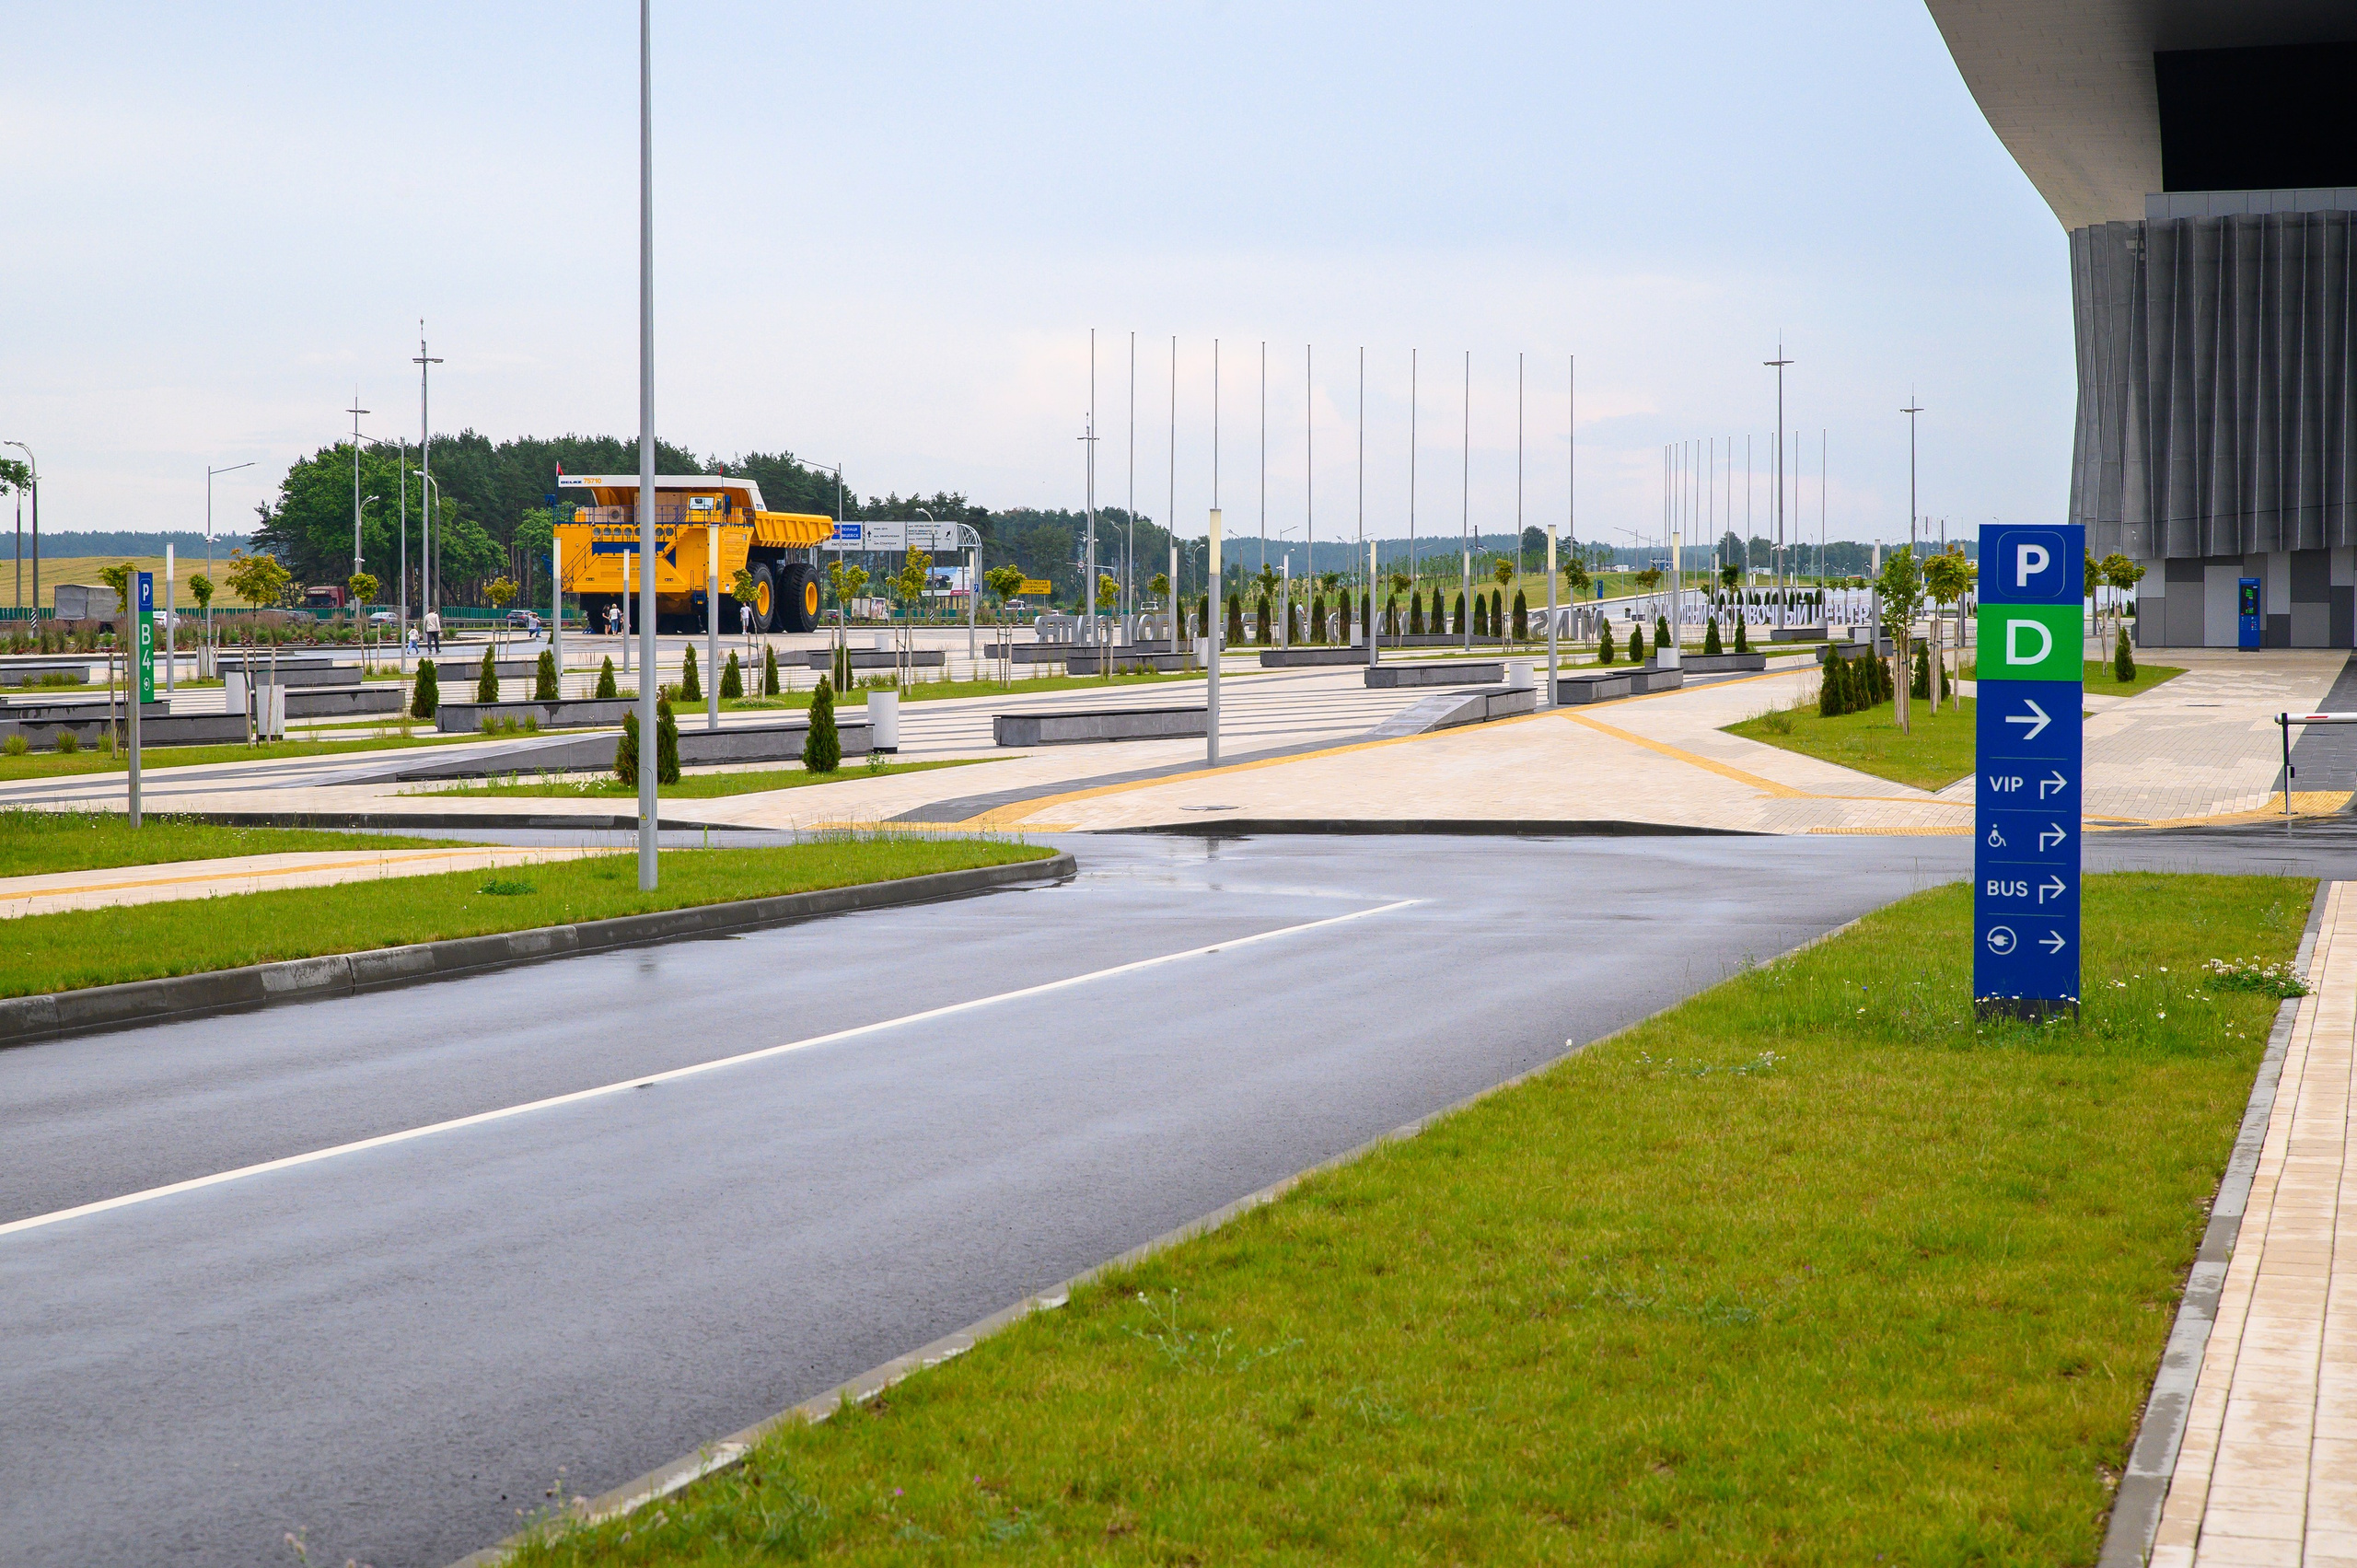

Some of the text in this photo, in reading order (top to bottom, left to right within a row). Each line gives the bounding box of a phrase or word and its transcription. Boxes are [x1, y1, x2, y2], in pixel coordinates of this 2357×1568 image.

[2016, 544, 2050, 587] P
[143, 583, 149, 601] P
[2005, 619, 2053, 665] D
[1989, 775, 2024, 793] VIP
[1987, 879, 2028, 898] BUS
